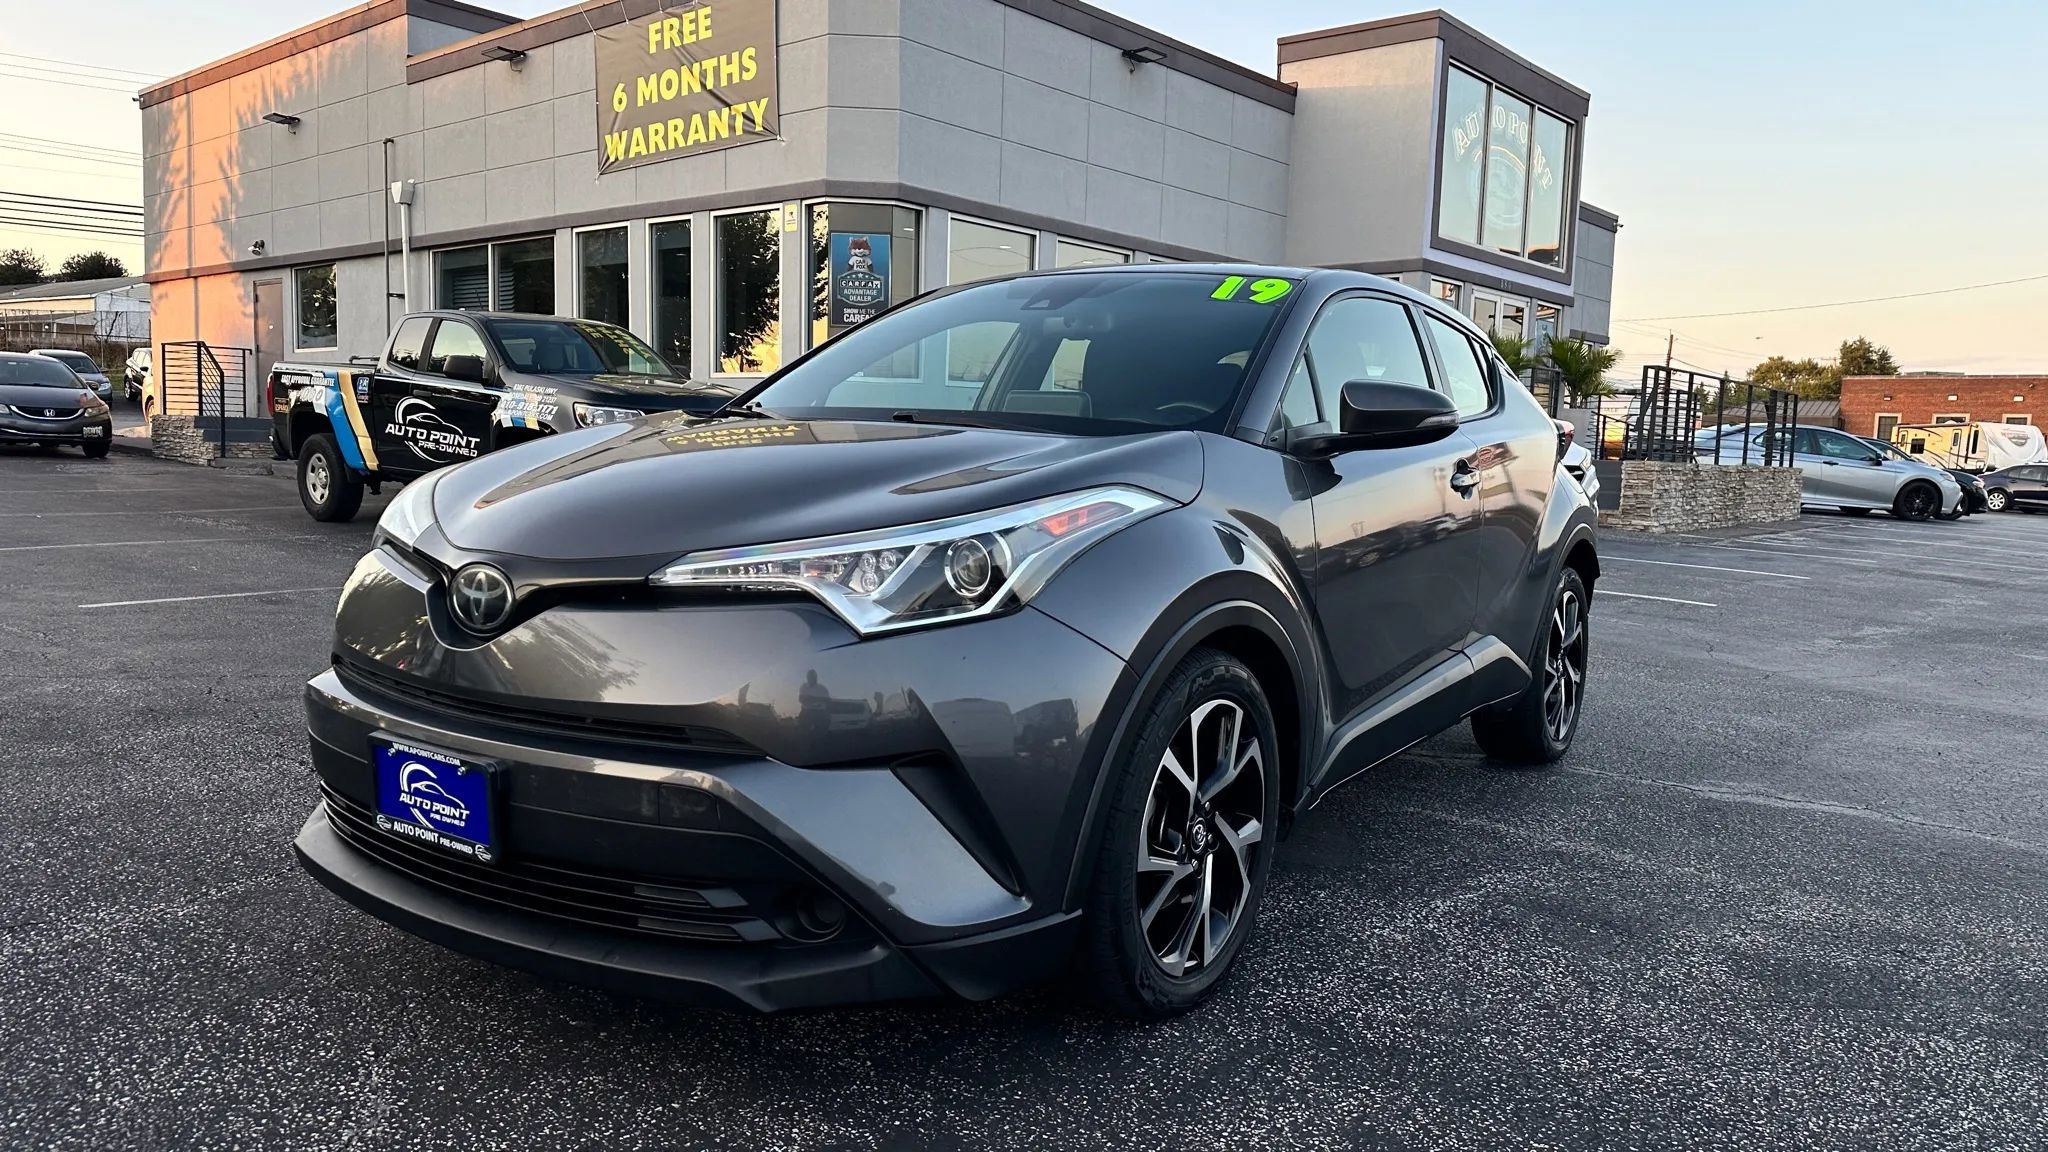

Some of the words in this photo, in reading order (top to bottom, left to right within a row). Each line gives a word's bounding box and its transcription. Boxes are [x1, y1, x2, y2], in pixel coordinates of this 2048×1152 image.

[648, 6, 712, 54] FREE
[612, 83, 627, 113] 6
[637, 47, 757, 107] MONTHS
[605, 97, 769, 162] WARRANTY
[841, 280, 880, 289] CARFAX
[843, 288, 878, 296] ADVANTAGE
[1210, 275, 1293, 304] 19
[843, 313, 873, 323] CARFA
[385, 423, 427, 440] AUTO
[430, 430, 480, 449] POINT
[418, 440, 478, 457] PRE-OWNED
[393, 742, 461, 766] WWW.APOINTCARS.COM
[400, 793, 431, 810] AUTO
[432, 802, 470, 820] POINT
[393, 821, 415, 836] AUTO
[415, 827, 438, 843] POINT
[439, 838, 473, 854] PRE-OWNED
